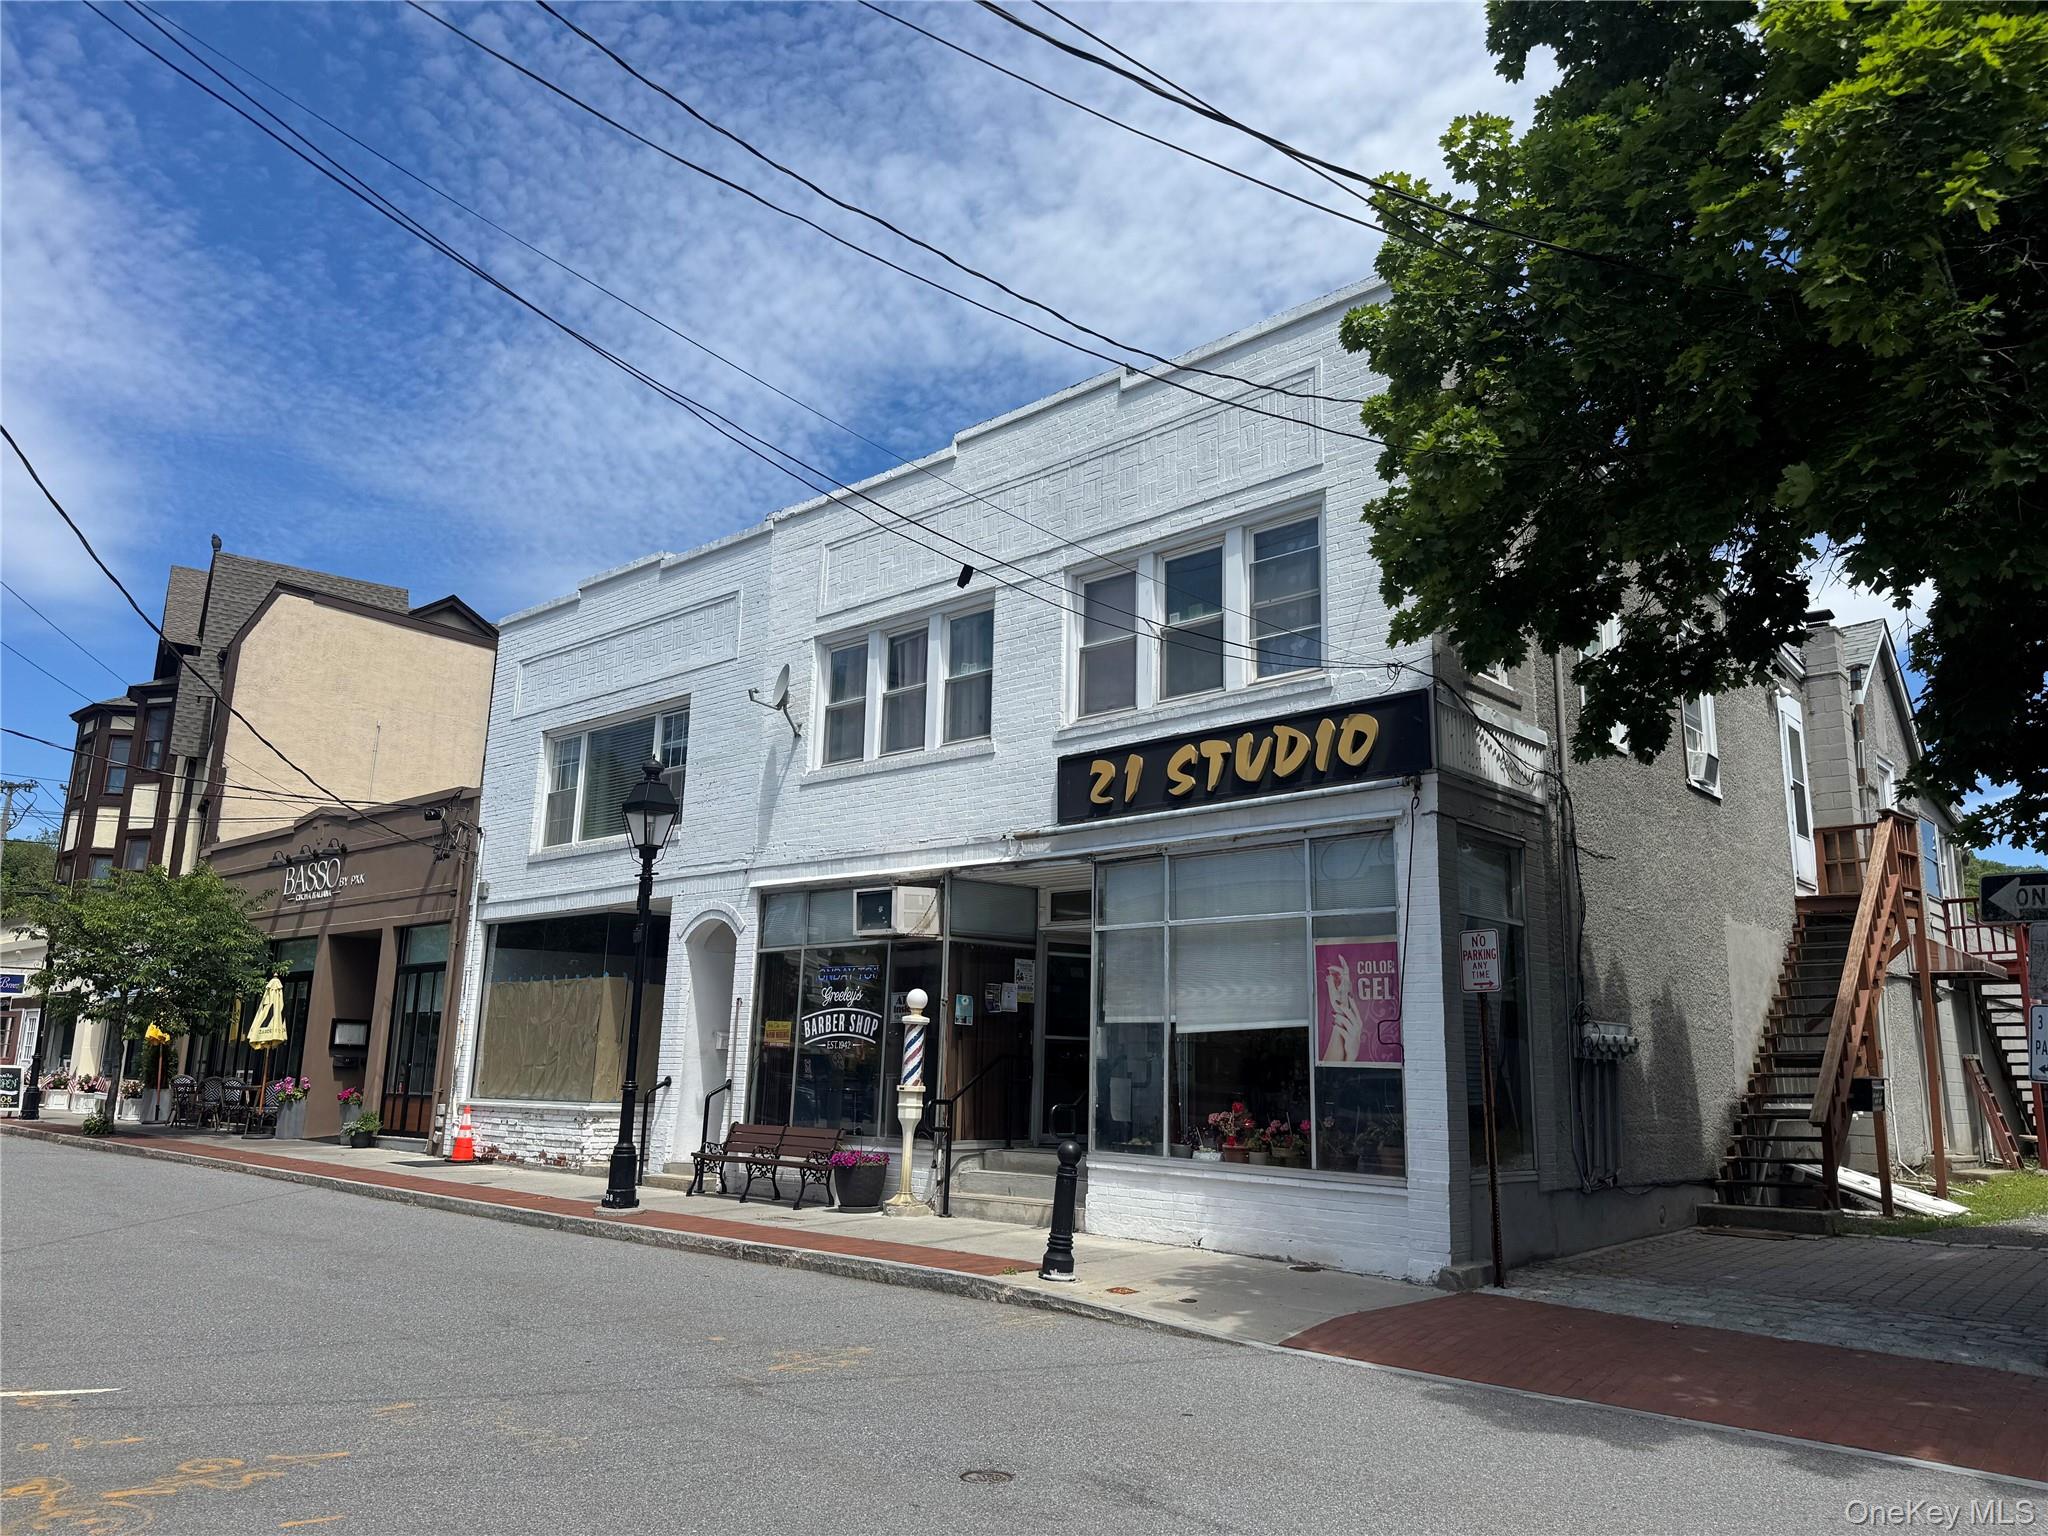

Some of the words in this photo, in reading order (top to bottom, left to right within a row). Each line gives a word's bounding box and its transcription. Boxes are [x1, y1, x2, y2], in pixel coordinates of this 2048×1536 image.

[1090, 753, 1144, 804] 21
[1167, 713, 1379, 796] STUDIO
[283, 858, 341, 896] BASSO
[339, 877, 349, 887] BY
[1471, 935, 1486, 947] NO
[1462, 948, 1497, 961] PARKING
[1357, 959, 1395, 974] COLOR
[1472, 961, 1488, 970] ANY
[1472, 970, 1490, 979] TIME
[1357, 977, 1395, 1000] GEL
[804, 1013, 846, 1038] BARBER
[849, 1013, 879, 1037] SHOP
[2038, 1015, 2044, 1030] 3
